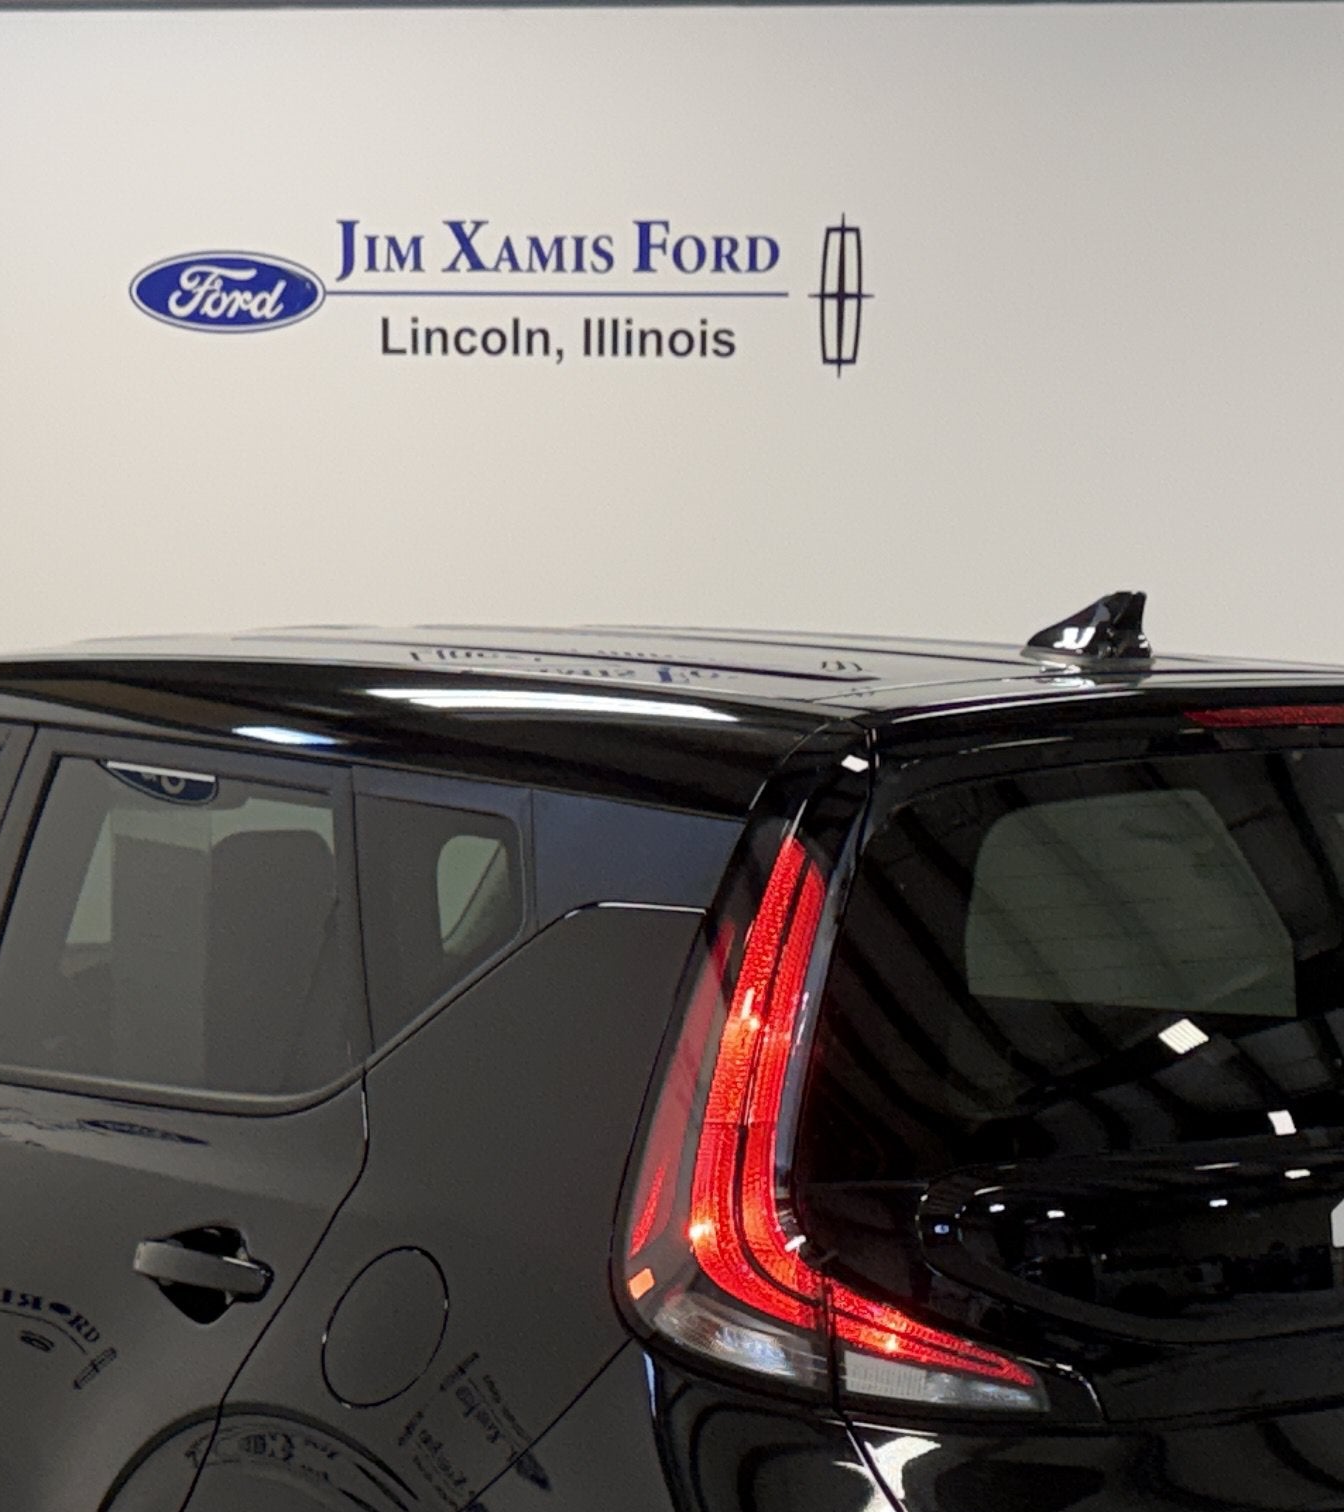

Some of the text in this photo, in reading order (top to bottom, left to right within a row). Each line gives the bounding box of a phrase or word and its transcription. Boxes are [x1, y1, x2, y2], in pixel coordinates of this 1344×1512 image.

[336, 220, 780, 281] JIM XAMIS FORD
[167, 266, 284, 320] Ford
[380, 316, 736, 364] Lincoln, Illinois
